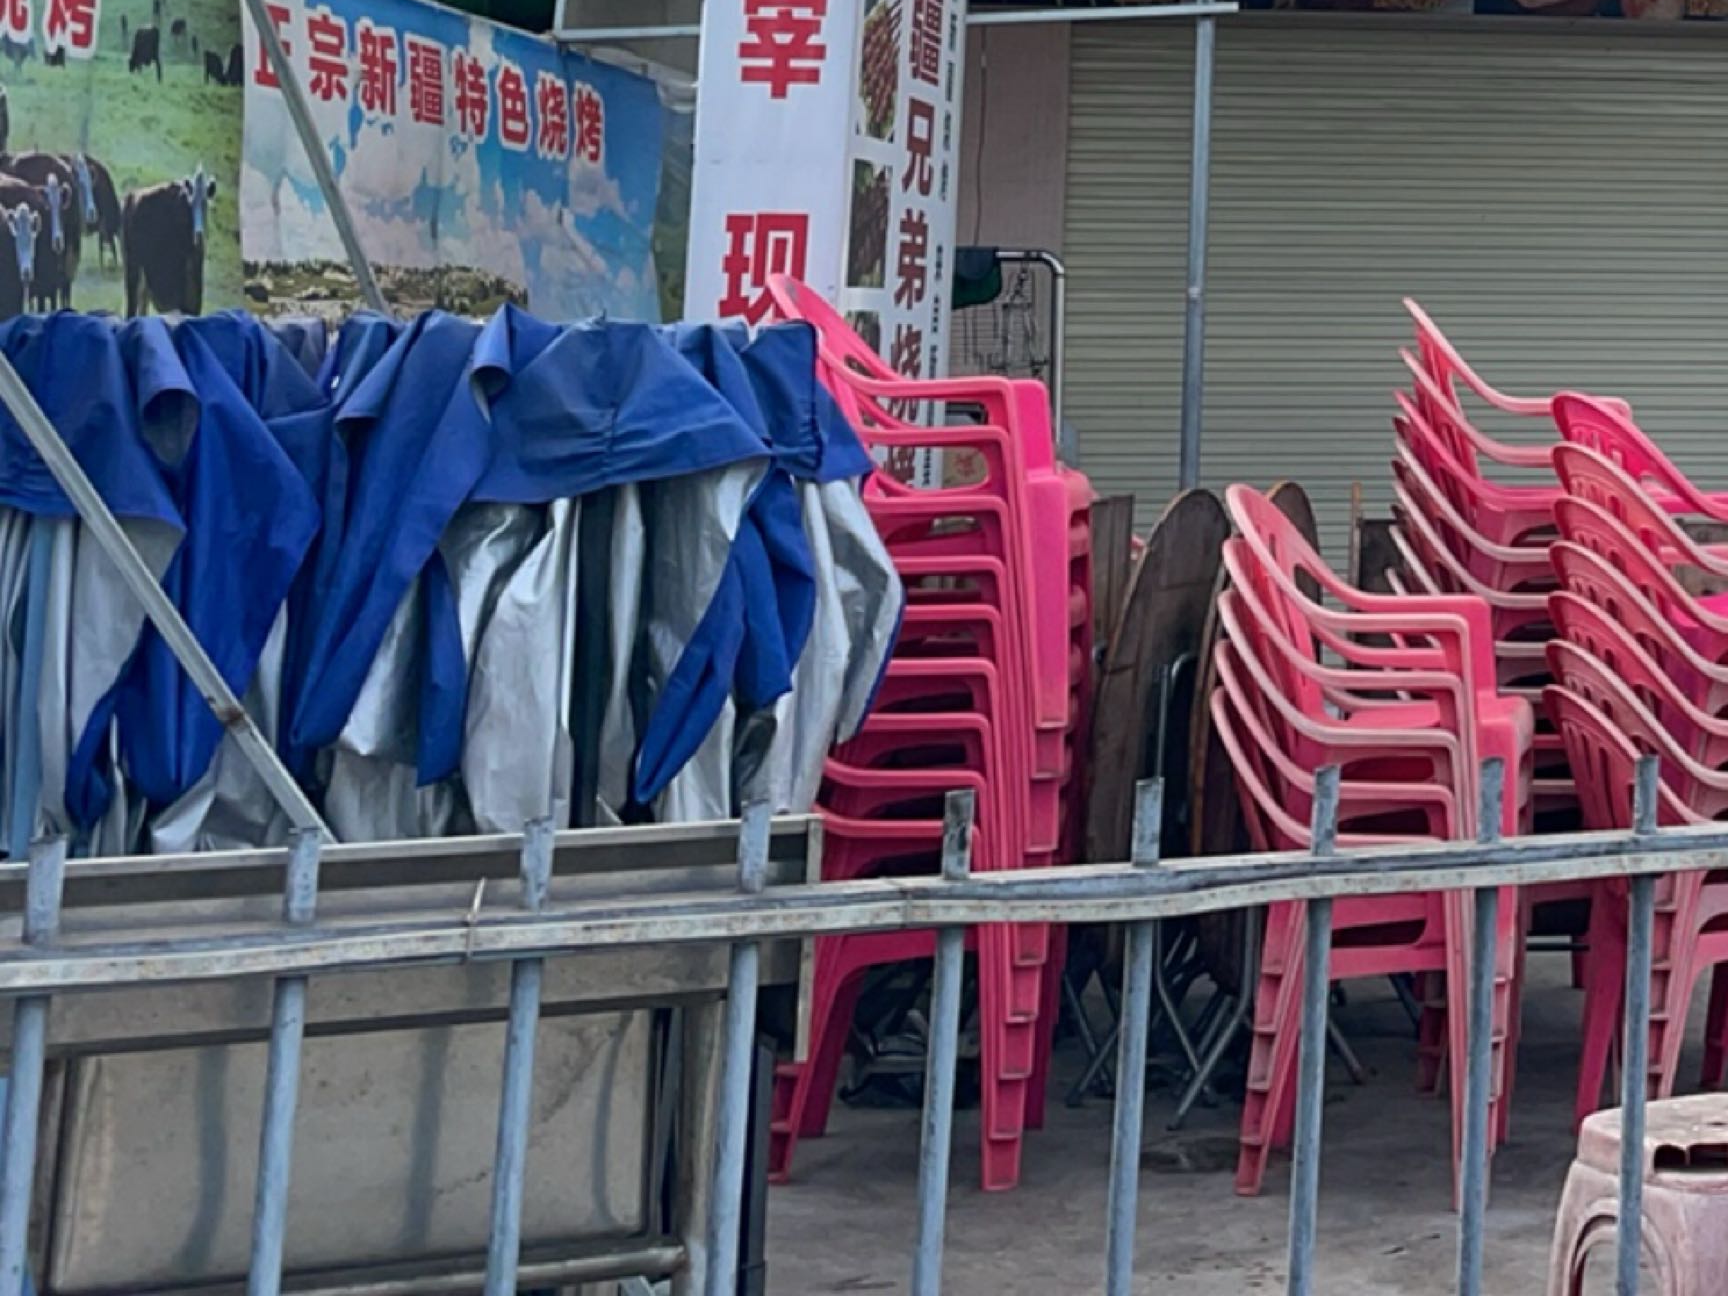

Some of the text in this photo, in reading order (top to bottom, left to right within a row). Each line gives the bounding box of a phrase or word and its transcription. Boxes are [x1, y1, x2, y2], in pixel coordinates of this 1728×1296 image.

[254, 5, 603, 162] 正宗新疆特色烧烤
